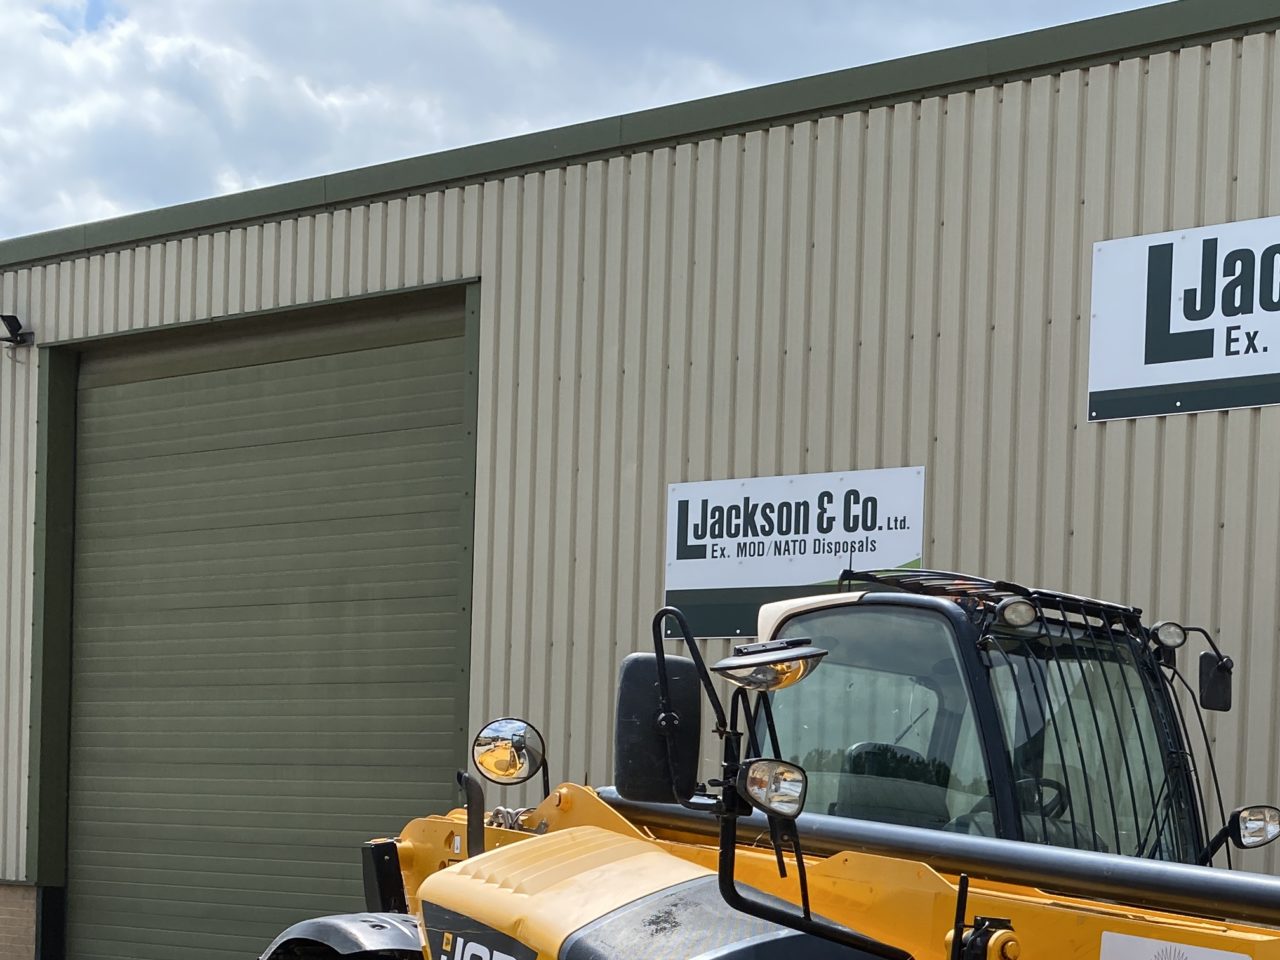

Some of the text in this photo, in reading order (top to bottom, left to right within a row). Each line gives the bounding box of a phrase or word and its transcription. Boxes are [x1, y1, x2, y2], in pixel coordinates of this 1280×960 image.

[1225, 325, 1269, 356] Ex.
[817, 490, 836, 534] &
[843, 489, 883, 532] Co.
[887, 516, 910, 531] Ltd.
[711, 537, 877, 559] Ex. MOD/NATO Disposals
